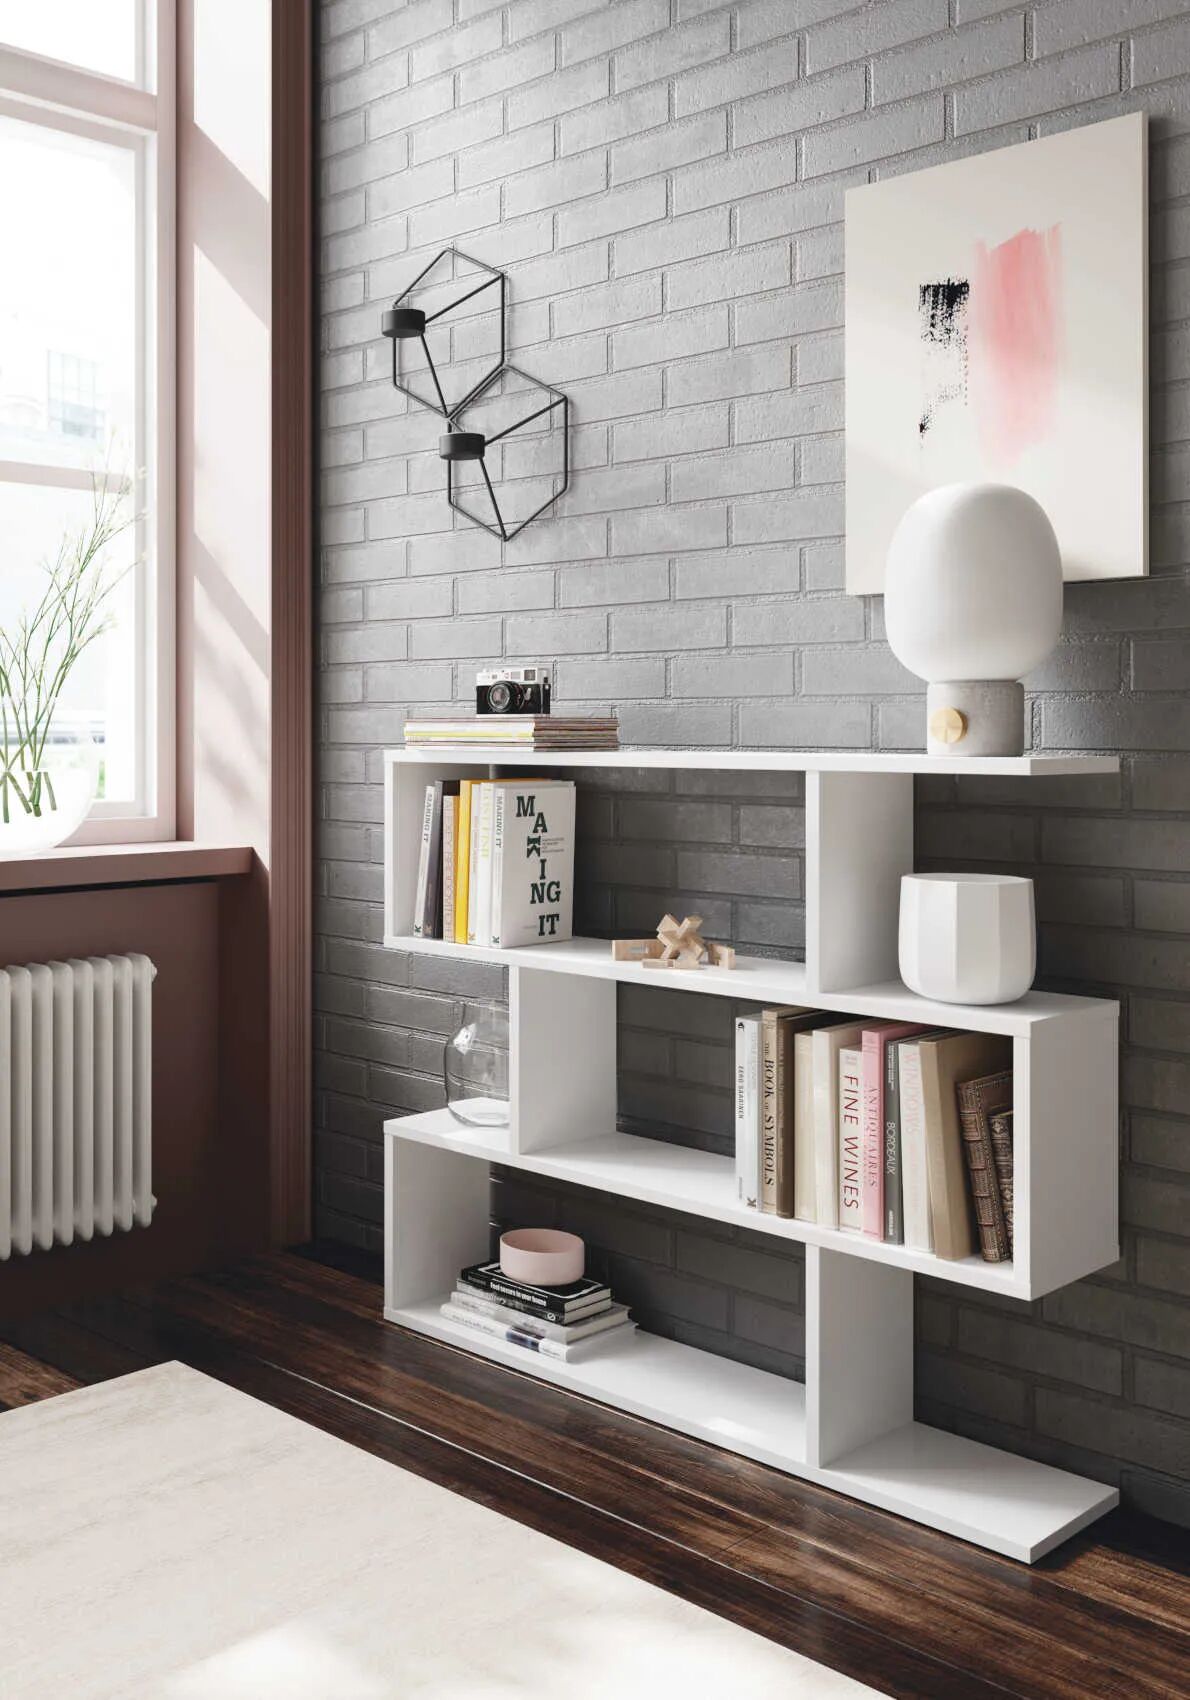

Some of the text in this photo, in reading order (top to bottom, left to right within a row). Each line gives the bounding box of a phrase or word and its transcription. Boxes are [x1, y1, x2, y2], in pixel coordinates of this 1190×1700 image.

[538, 914, 560, 936] IT
[764, 1060, 774, 1098] BOOK
[764, 1114, 774, 1186] SYMBOLS
[844, 1075, 859, 1209] FINE WINES
[867, 1087, 878, 1188] ANTIQUAIRES
[886, 1121, 896, 1175] BORDEAUX
